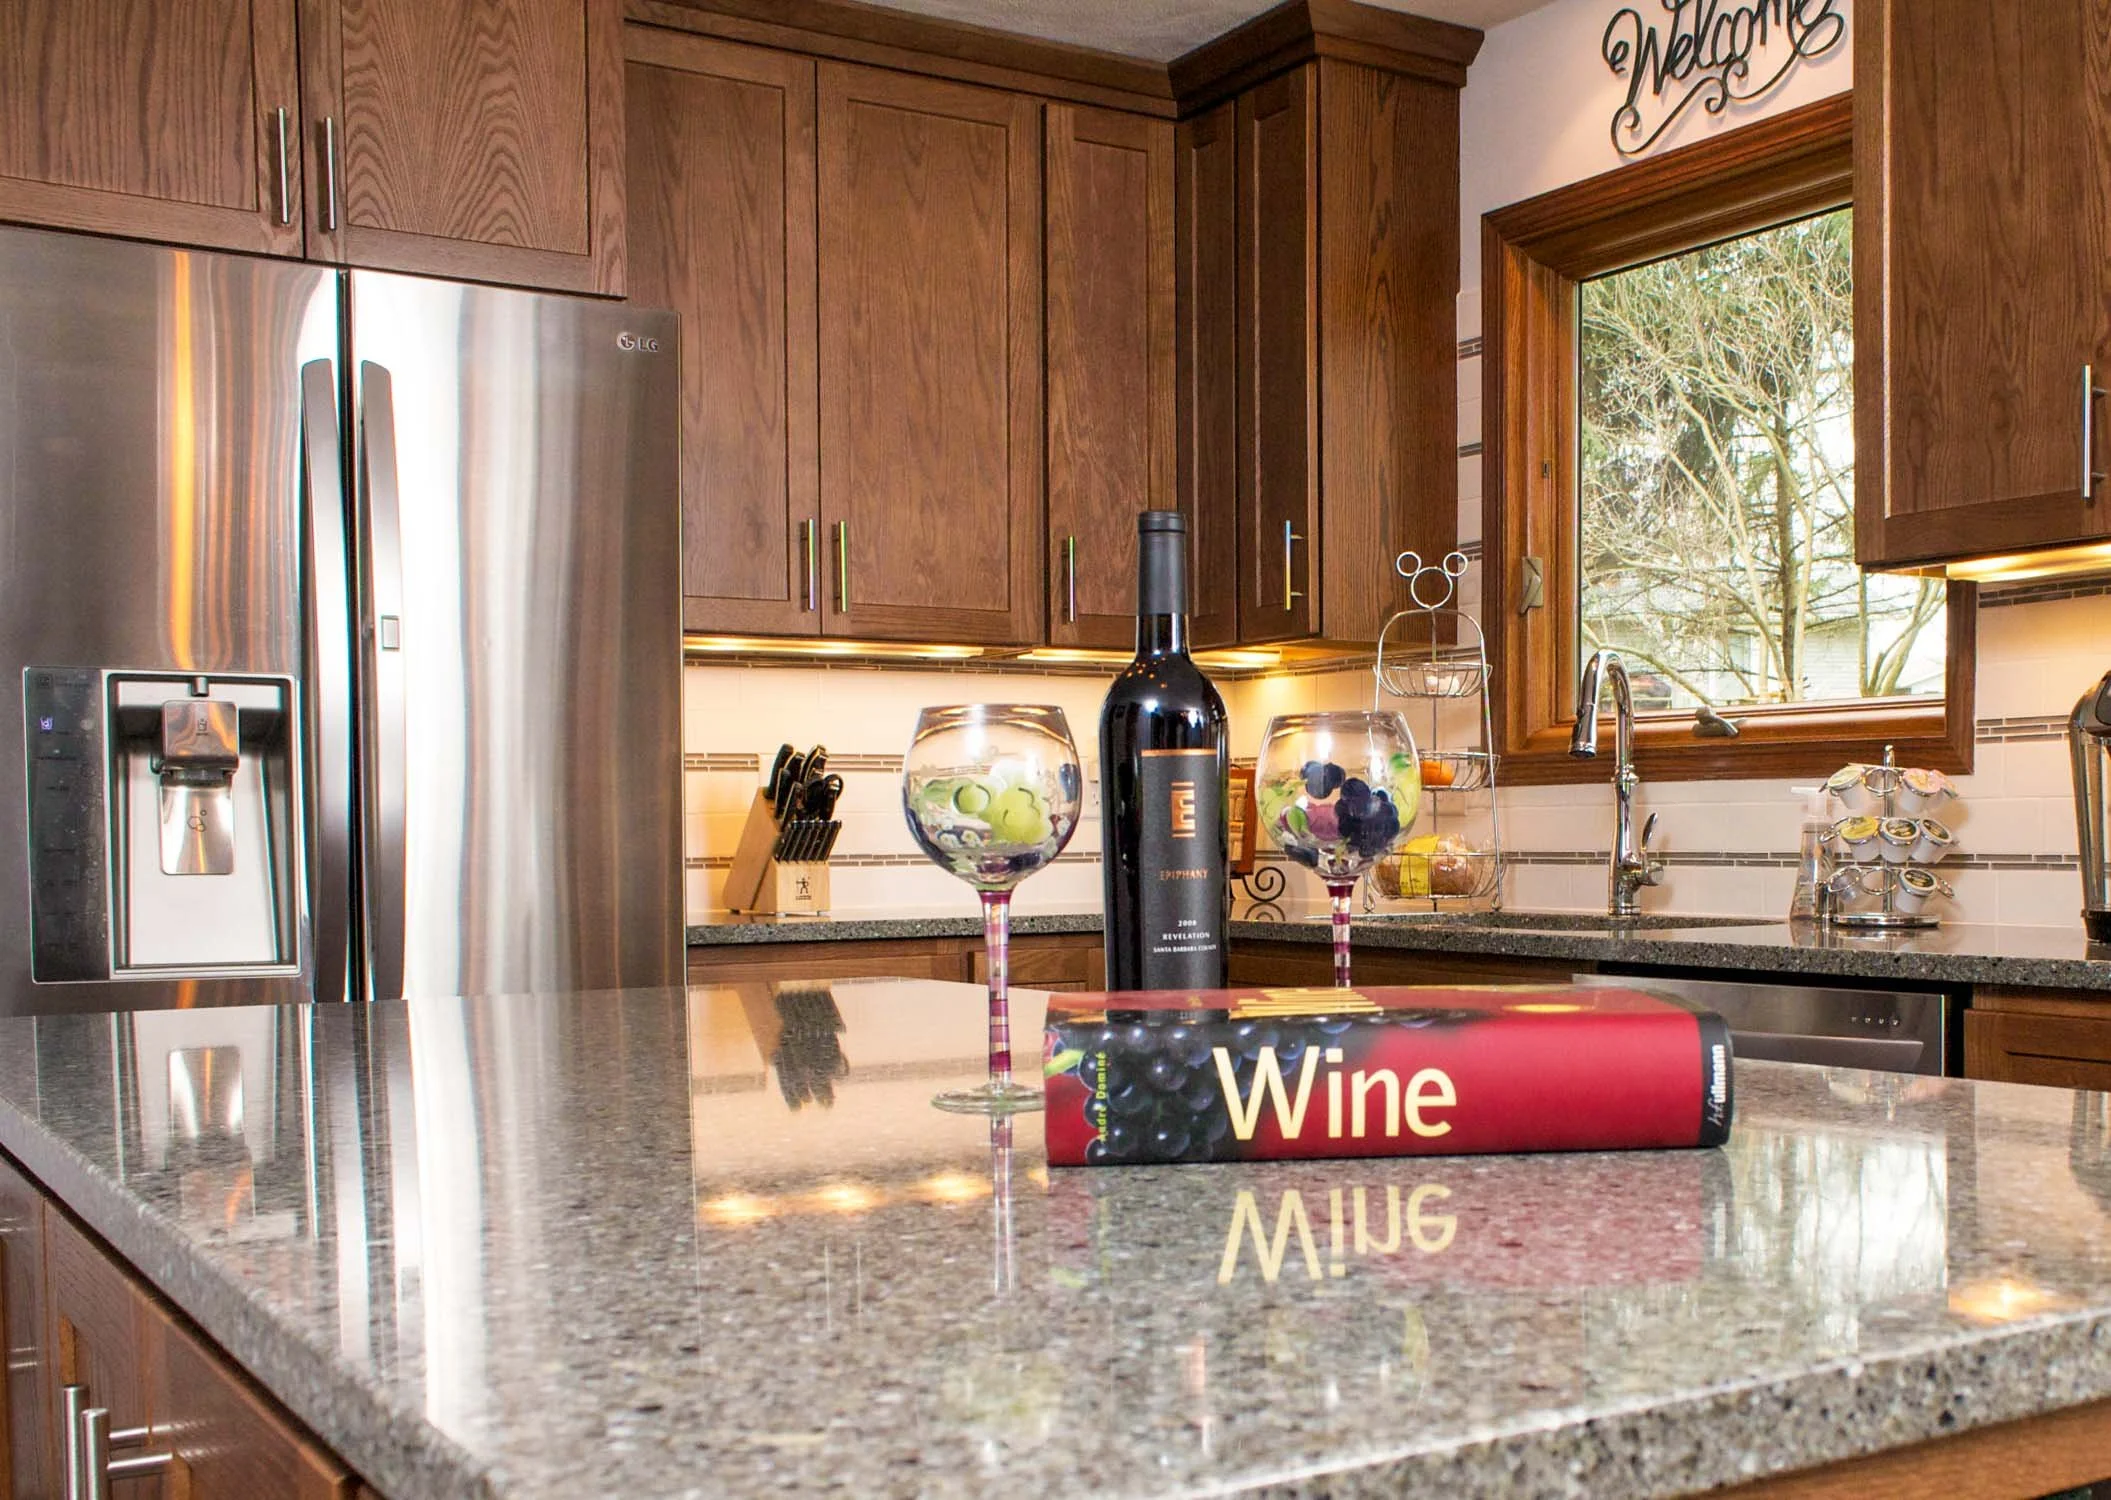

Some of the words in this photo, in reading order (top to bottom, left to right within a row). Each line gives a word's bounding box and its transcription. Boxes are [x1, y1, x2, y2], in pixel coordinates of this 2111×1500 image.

[1602, 0, 1844, 150] Welcome
[638, 337, 658, 352] LG
[1160, 868, 1208, 880] EPIPHANY
[1162, 932, 1211, 940] REVELATION
[1212, 1046, 1458, 1142] Wine
